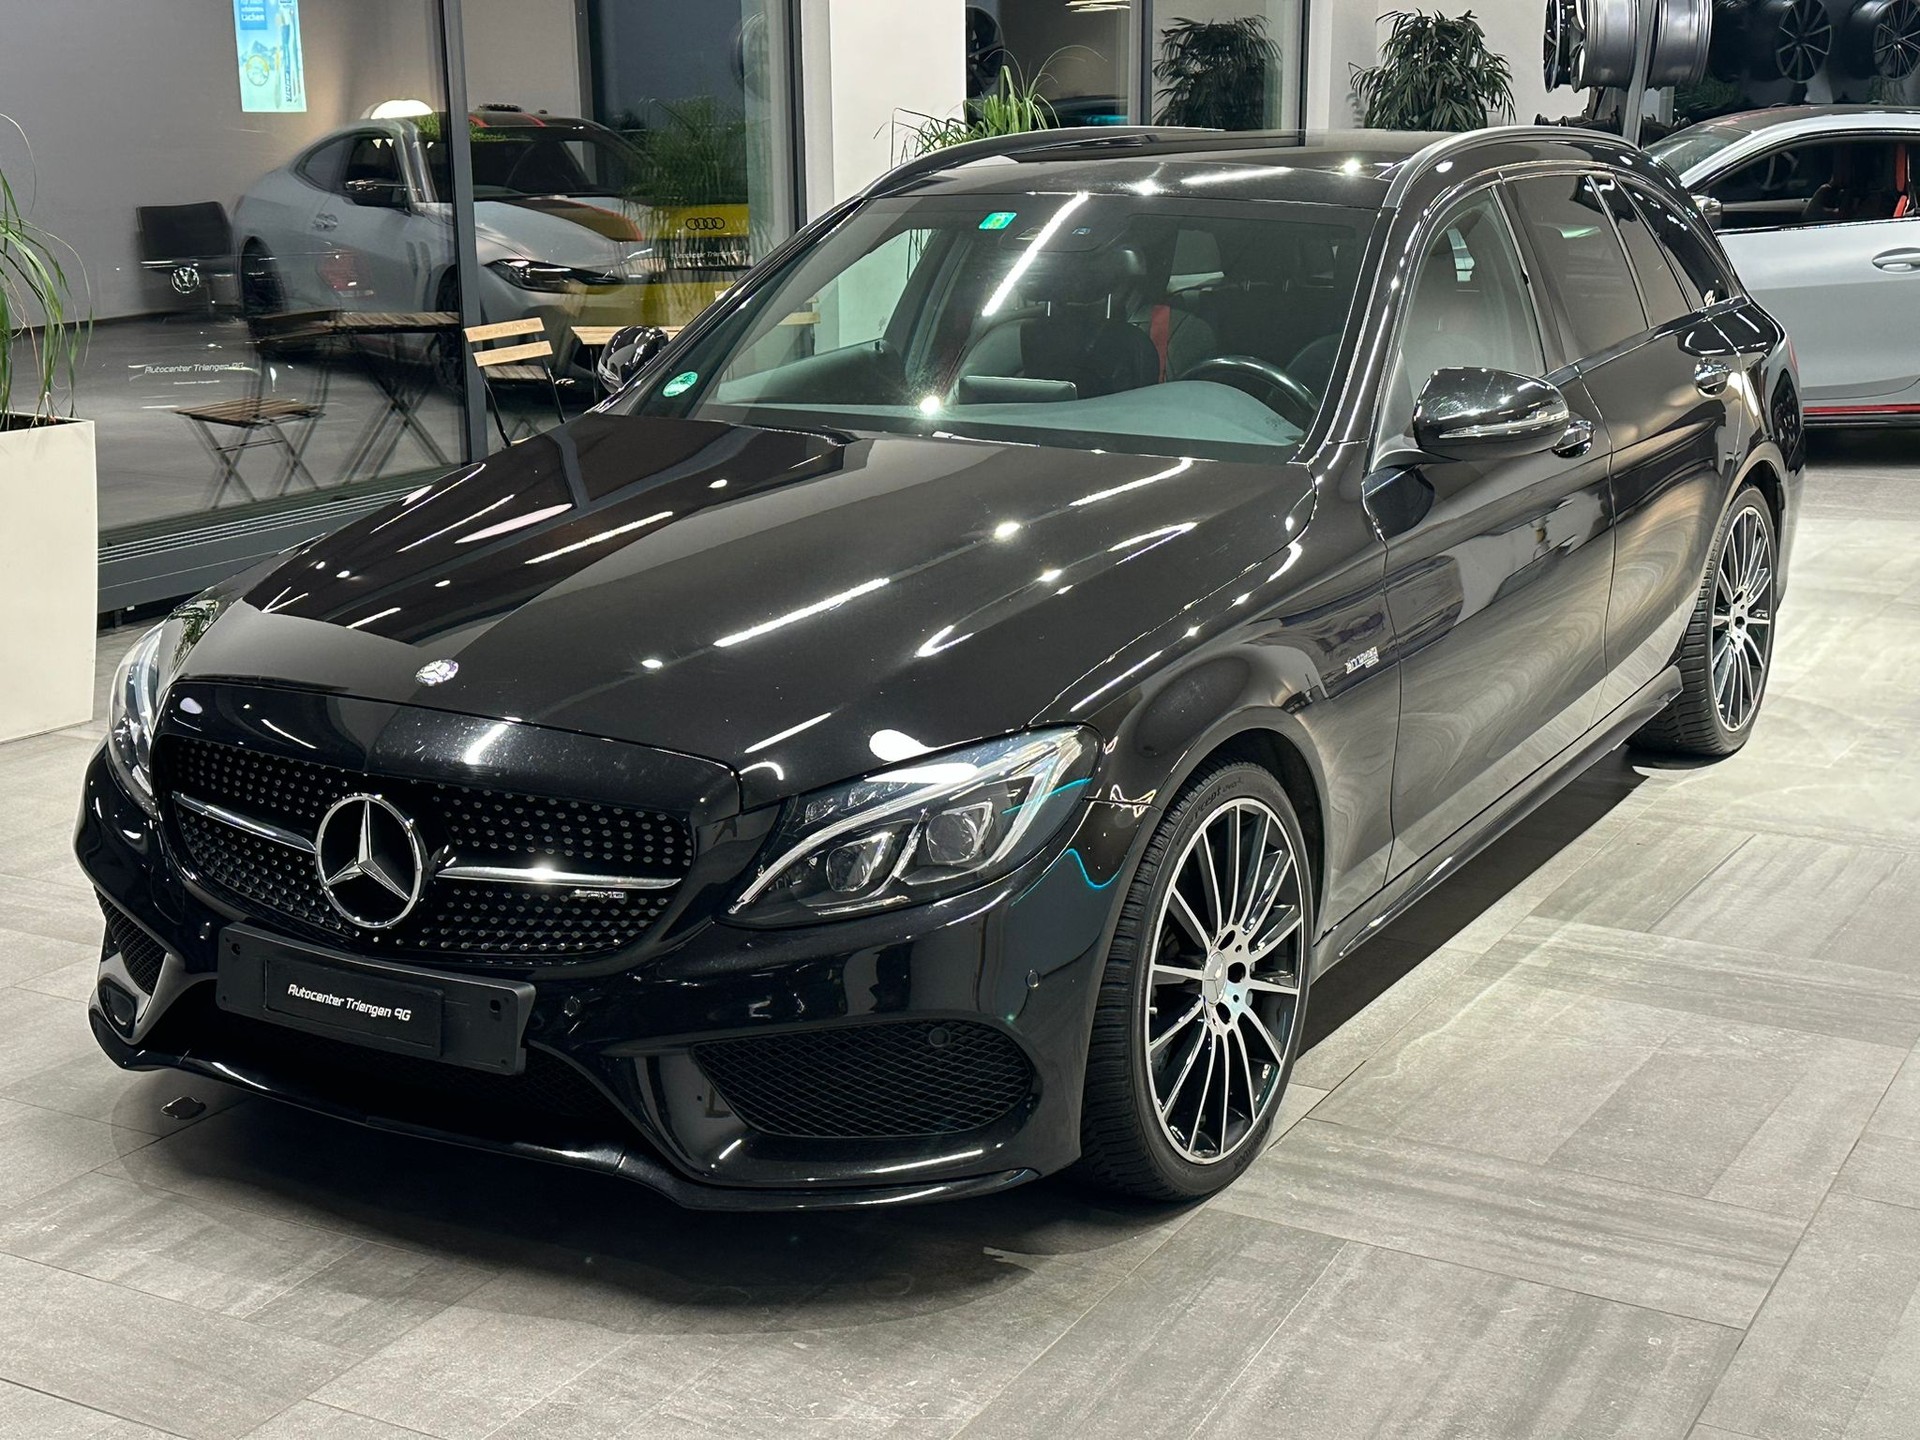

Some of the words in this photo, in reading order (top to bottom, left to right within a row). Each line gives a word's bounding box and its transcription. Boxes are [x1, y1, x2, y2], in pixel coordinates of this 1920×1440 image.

[144, 365, 192, 374] Autocenter
[287, 983, 345, 1006] Autocenter
[346, 997, 392, 1018] Triengen
